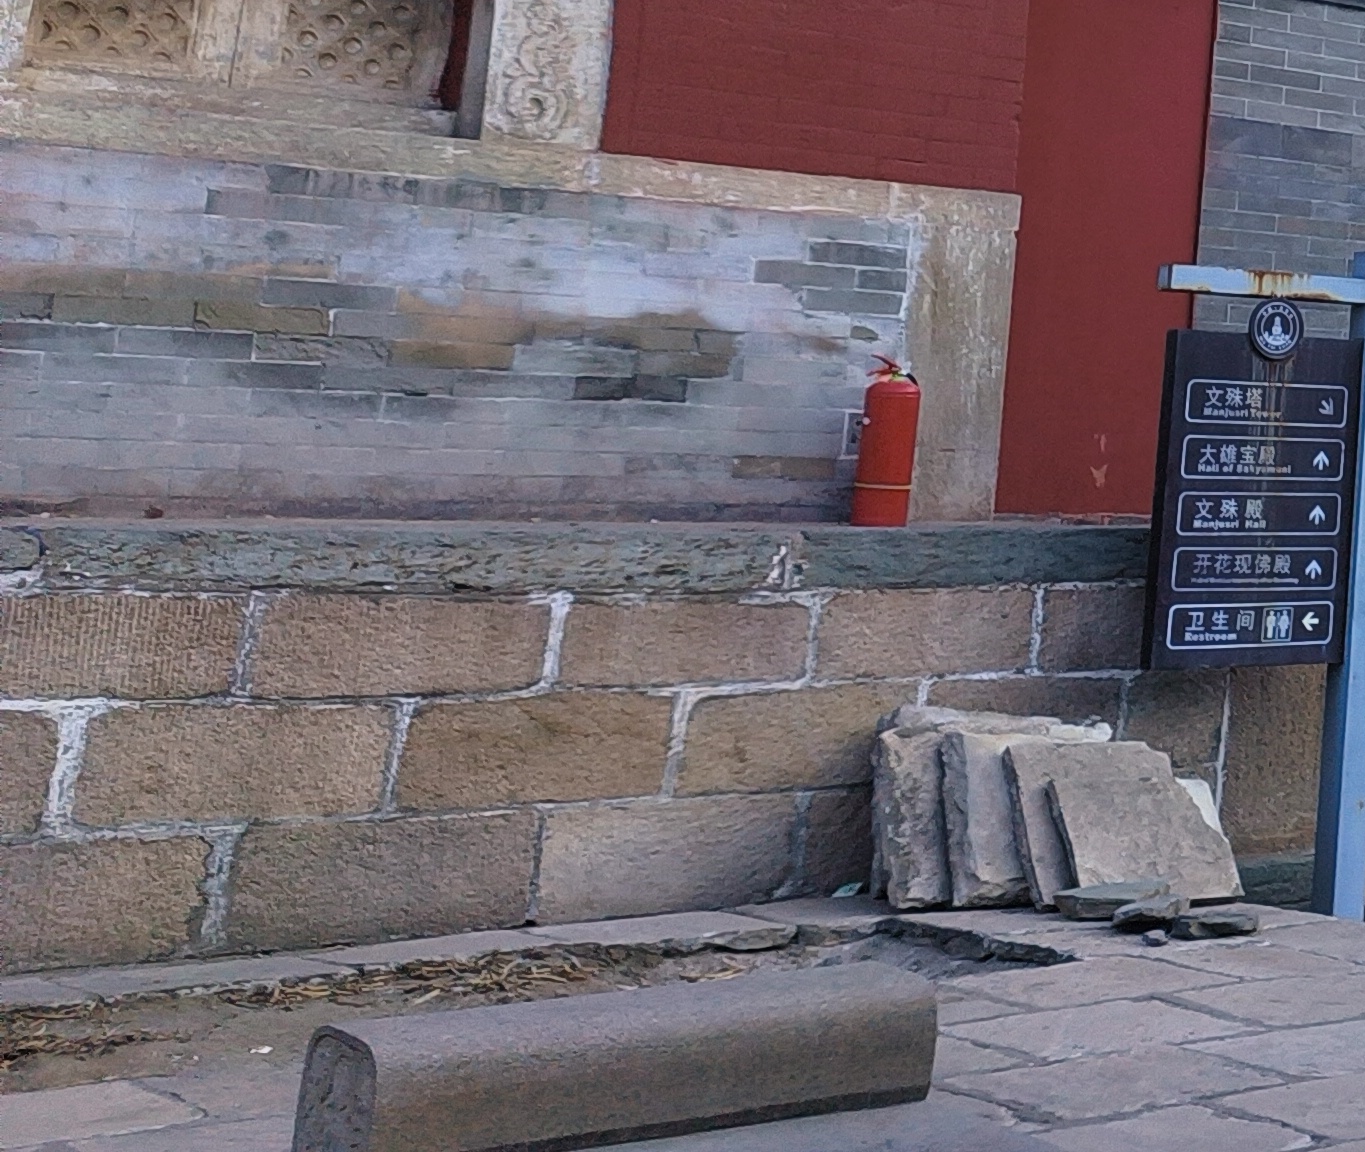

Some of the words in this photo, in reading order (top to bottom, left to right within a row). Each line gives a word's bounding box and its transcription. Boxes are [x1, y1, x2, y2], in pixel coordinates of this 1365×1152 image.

[1204, 385, 1264, 409] 文殊塔
[1198, 443, 1276, 466] 大雄宝殿
[1198, 463, 1220, 473] Hall
[1222, 463, 1234, 473] of
[1194, 497, 1264, 520] 文殊殿
[1193, 519, 1240, 531] Manjusri
[1244, 519, 1267, 530] Hall
[1193, 552, 1292, 575] 开花现佛殿
[1184, 609, 1256, 632] 卫生间
[1184, 631, 1238, 642] Restroom
